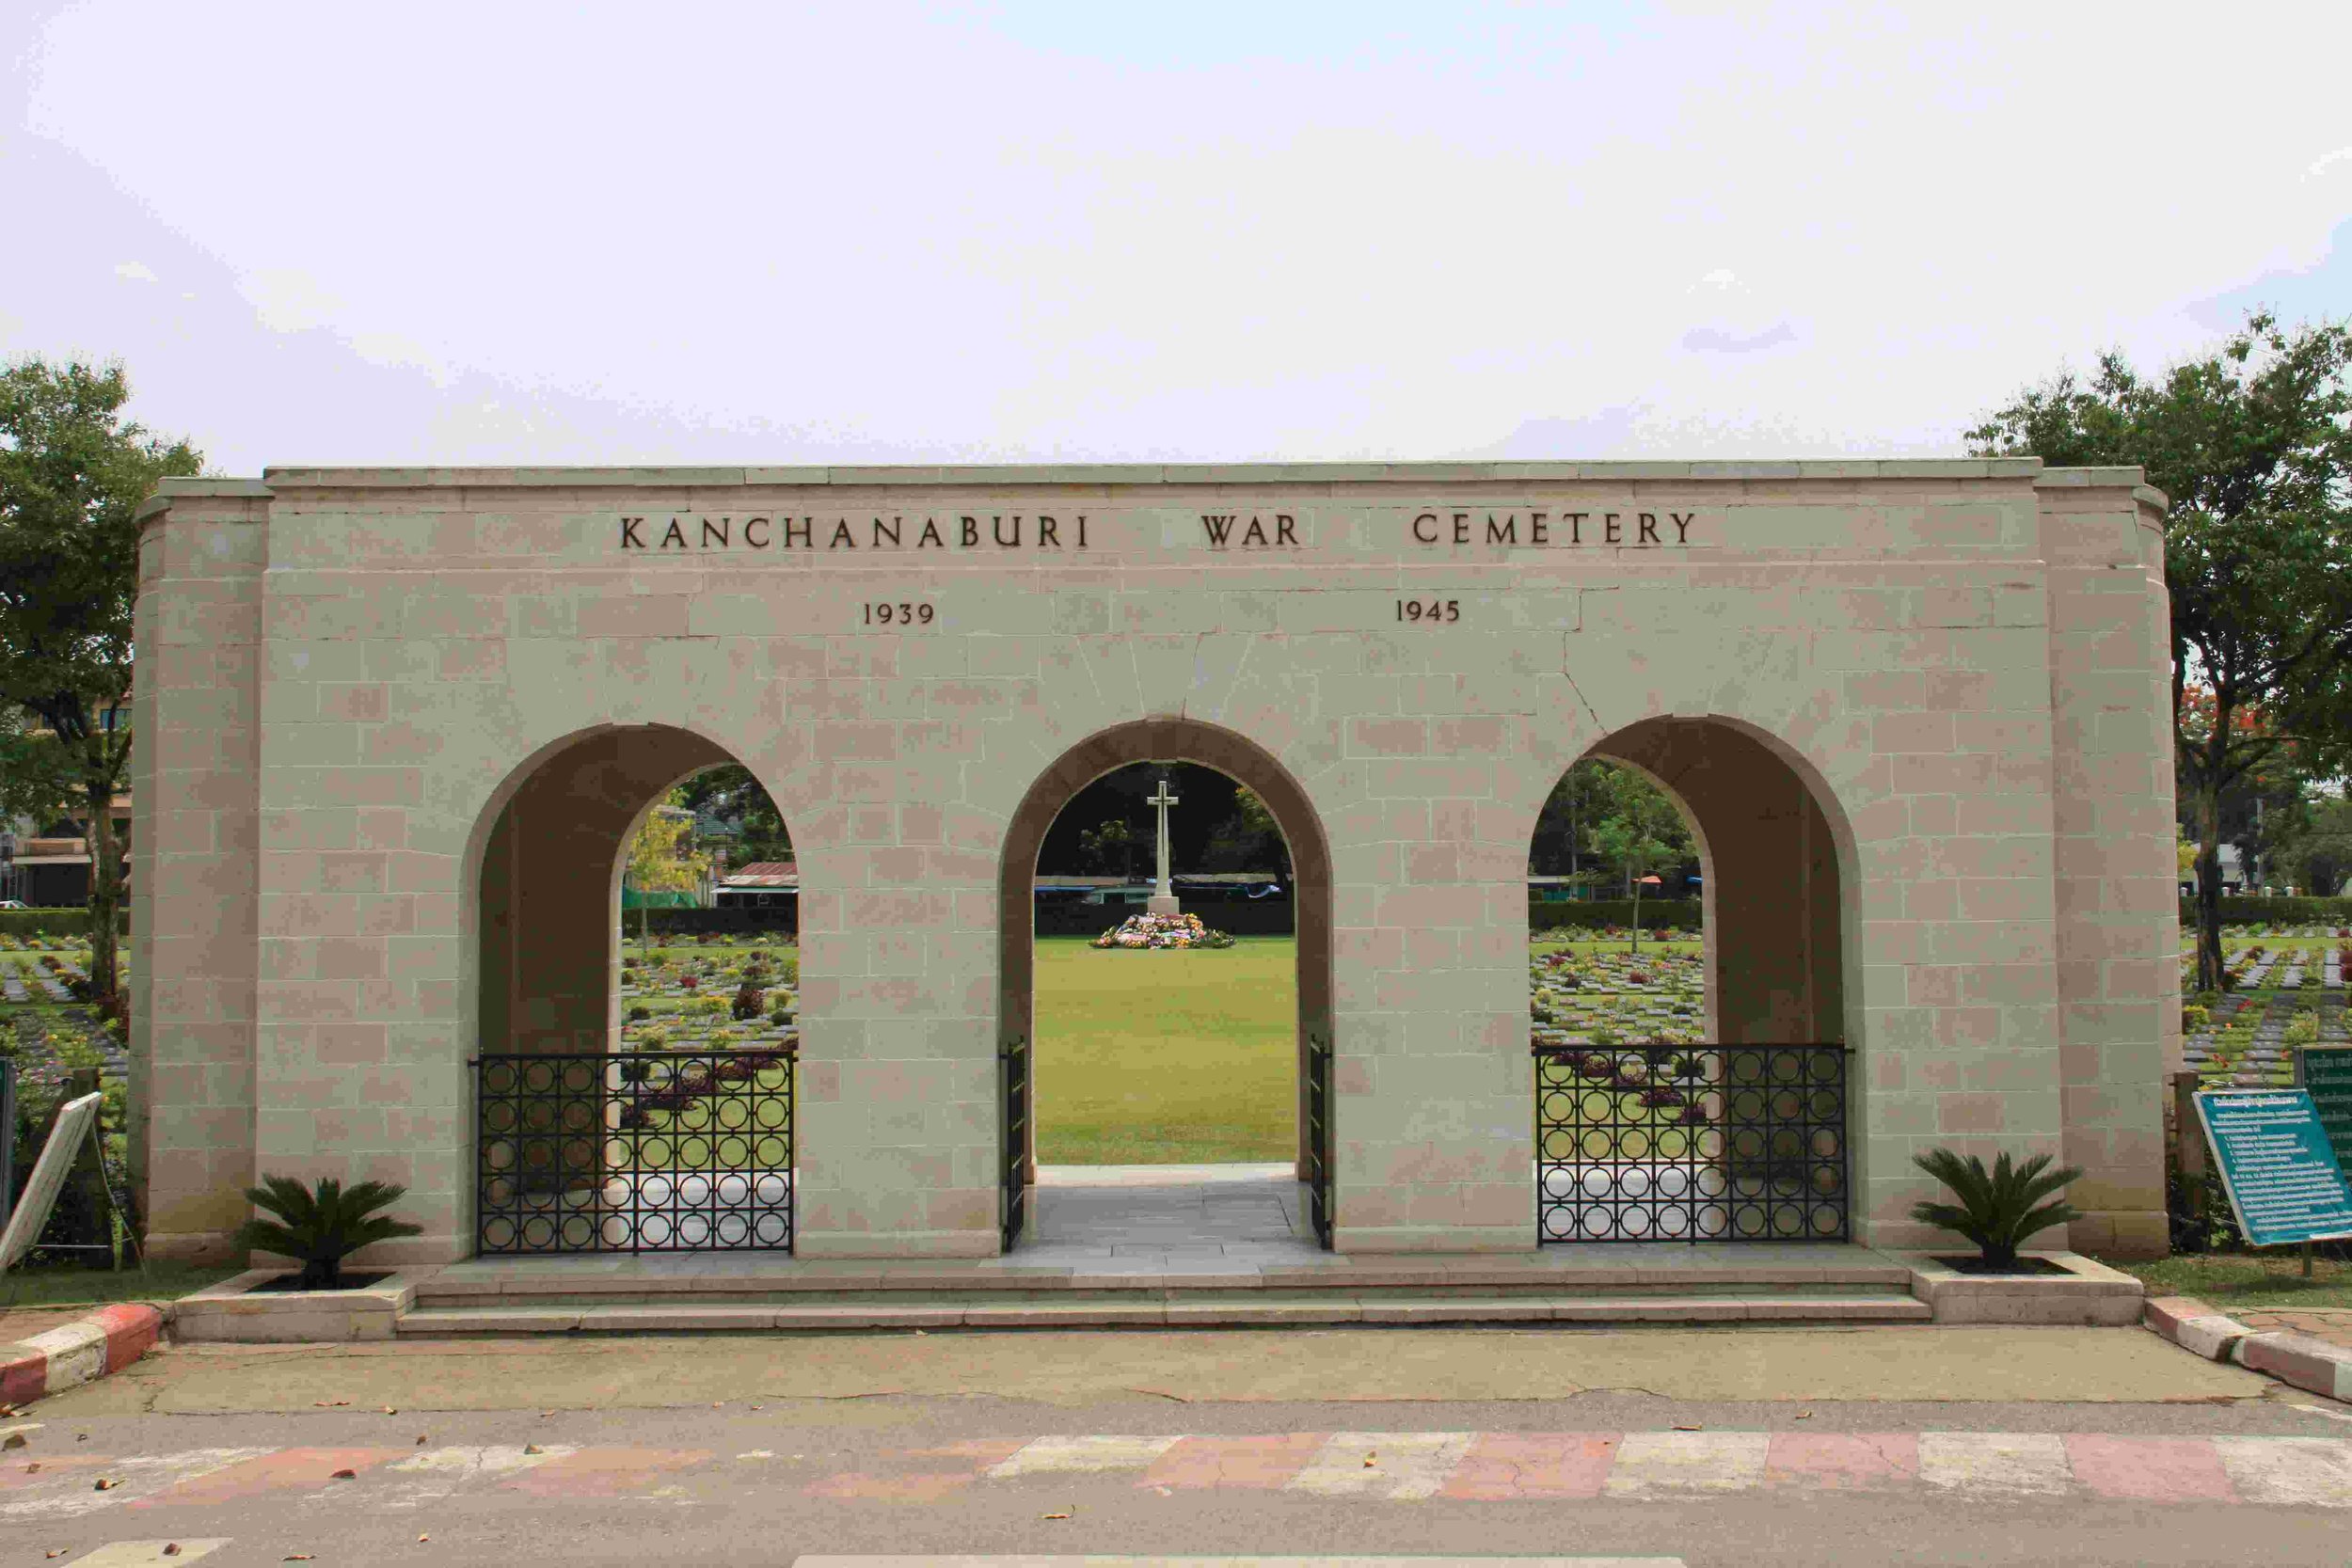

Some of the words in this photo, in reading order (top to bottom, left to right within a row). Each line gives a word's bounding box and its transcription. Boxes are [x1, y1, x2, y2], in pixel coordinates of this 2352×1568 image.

[620, 515, 1089, 548] KANCHANABURI
[1201, 514, 1299, 546] WAR
[1413, 513, 1695, 545] CEMETERY
[864, 603, 934, 625] 1939
[1396, 599, 1460, 622] 1945
